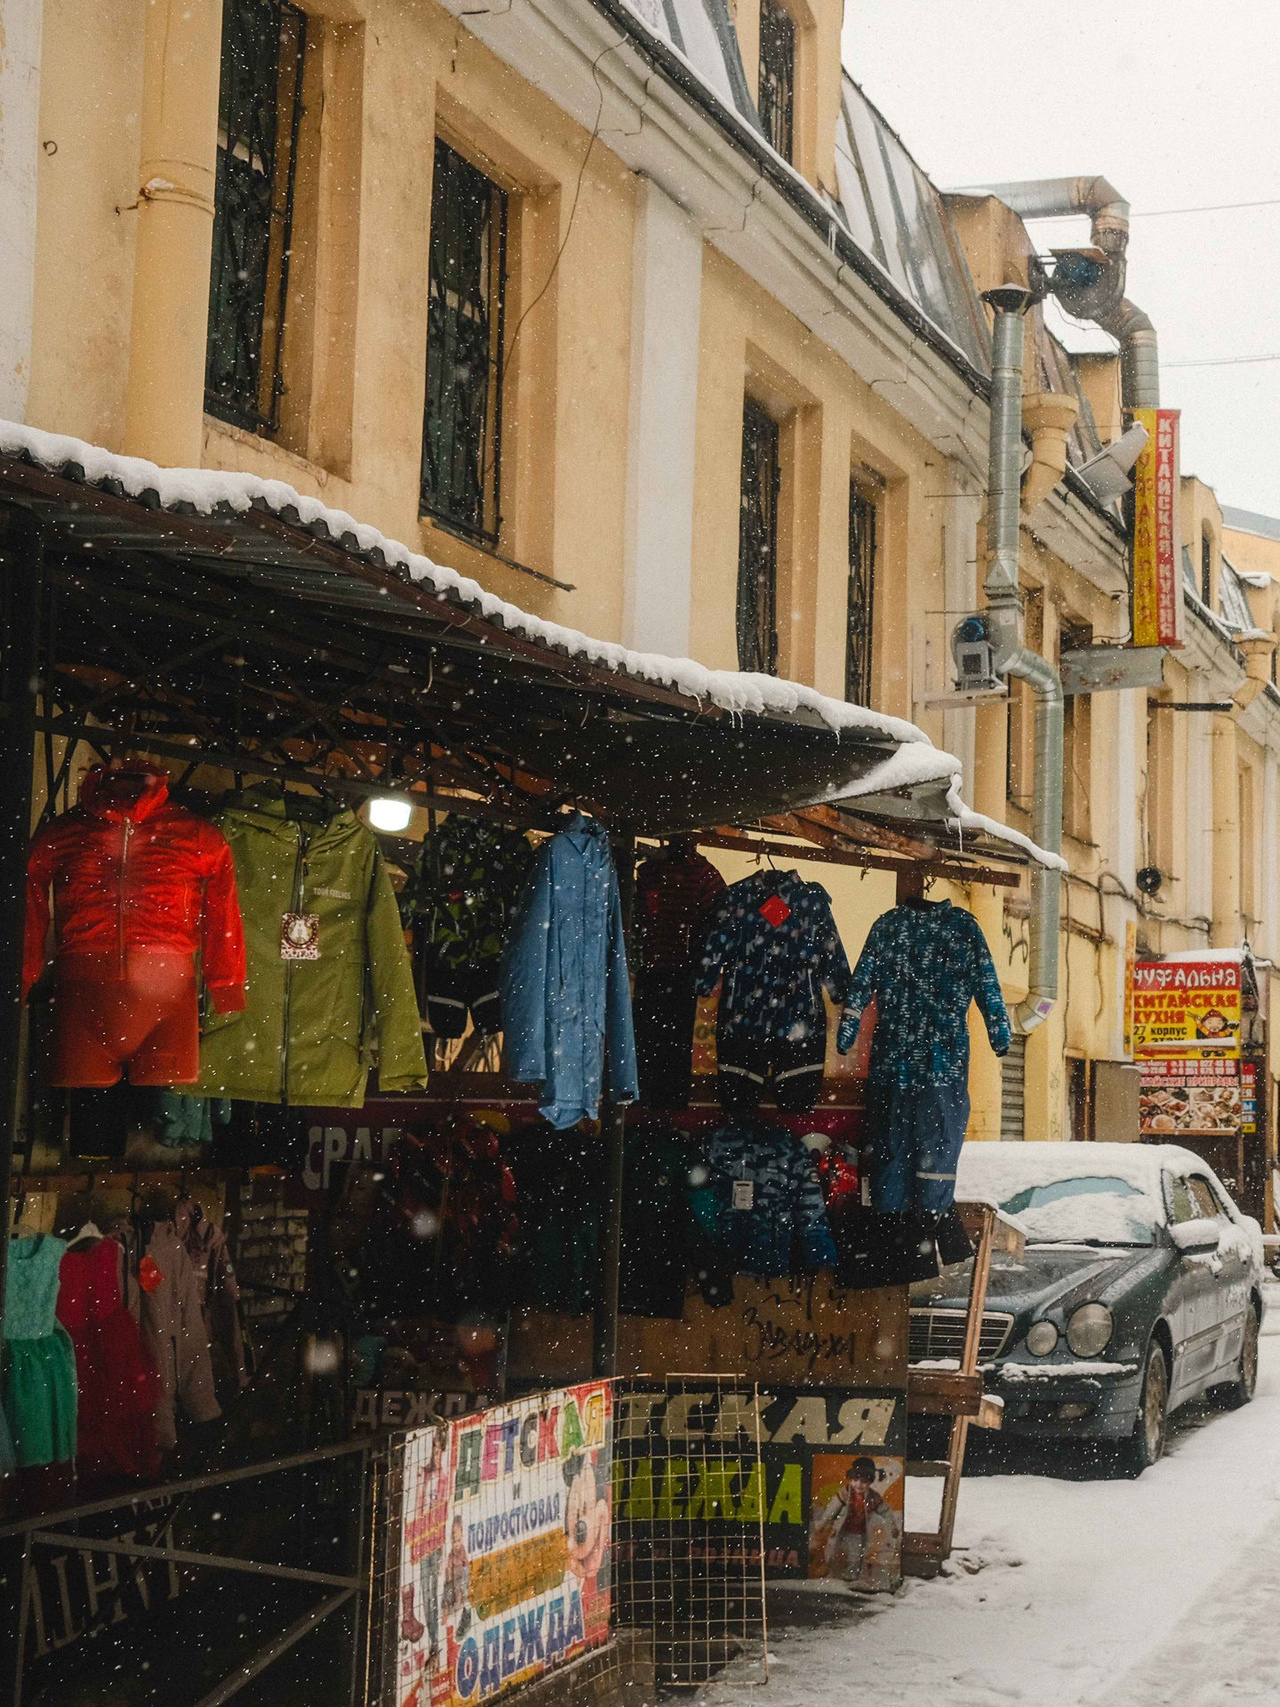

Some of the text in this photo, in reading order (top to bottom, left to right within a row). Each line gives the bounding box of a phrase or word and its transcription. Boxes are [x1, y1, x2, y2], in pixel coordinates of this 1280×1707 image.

[1158, 418, 1174, 554] КИТАЙСКАЯ
[1134, 990, 1238, 1009] КИТАЙСКАЯ
[1134, 1010, 1186, 1024] КУХНЯ
[1133, 1026, 1187, 1037] 27 корпус
[454, 1388, 607, 1502] ДЕТСКАЯ
[620, 1392, 896, 1447] ТСКАЯ
[613, 1456, 803, 1524] ДЕЖДА
[467, 1493, 561, 1553] ПОДРОСТКОВАЯ
[456, 1590, 584, 1699] ОДЕЖДА
